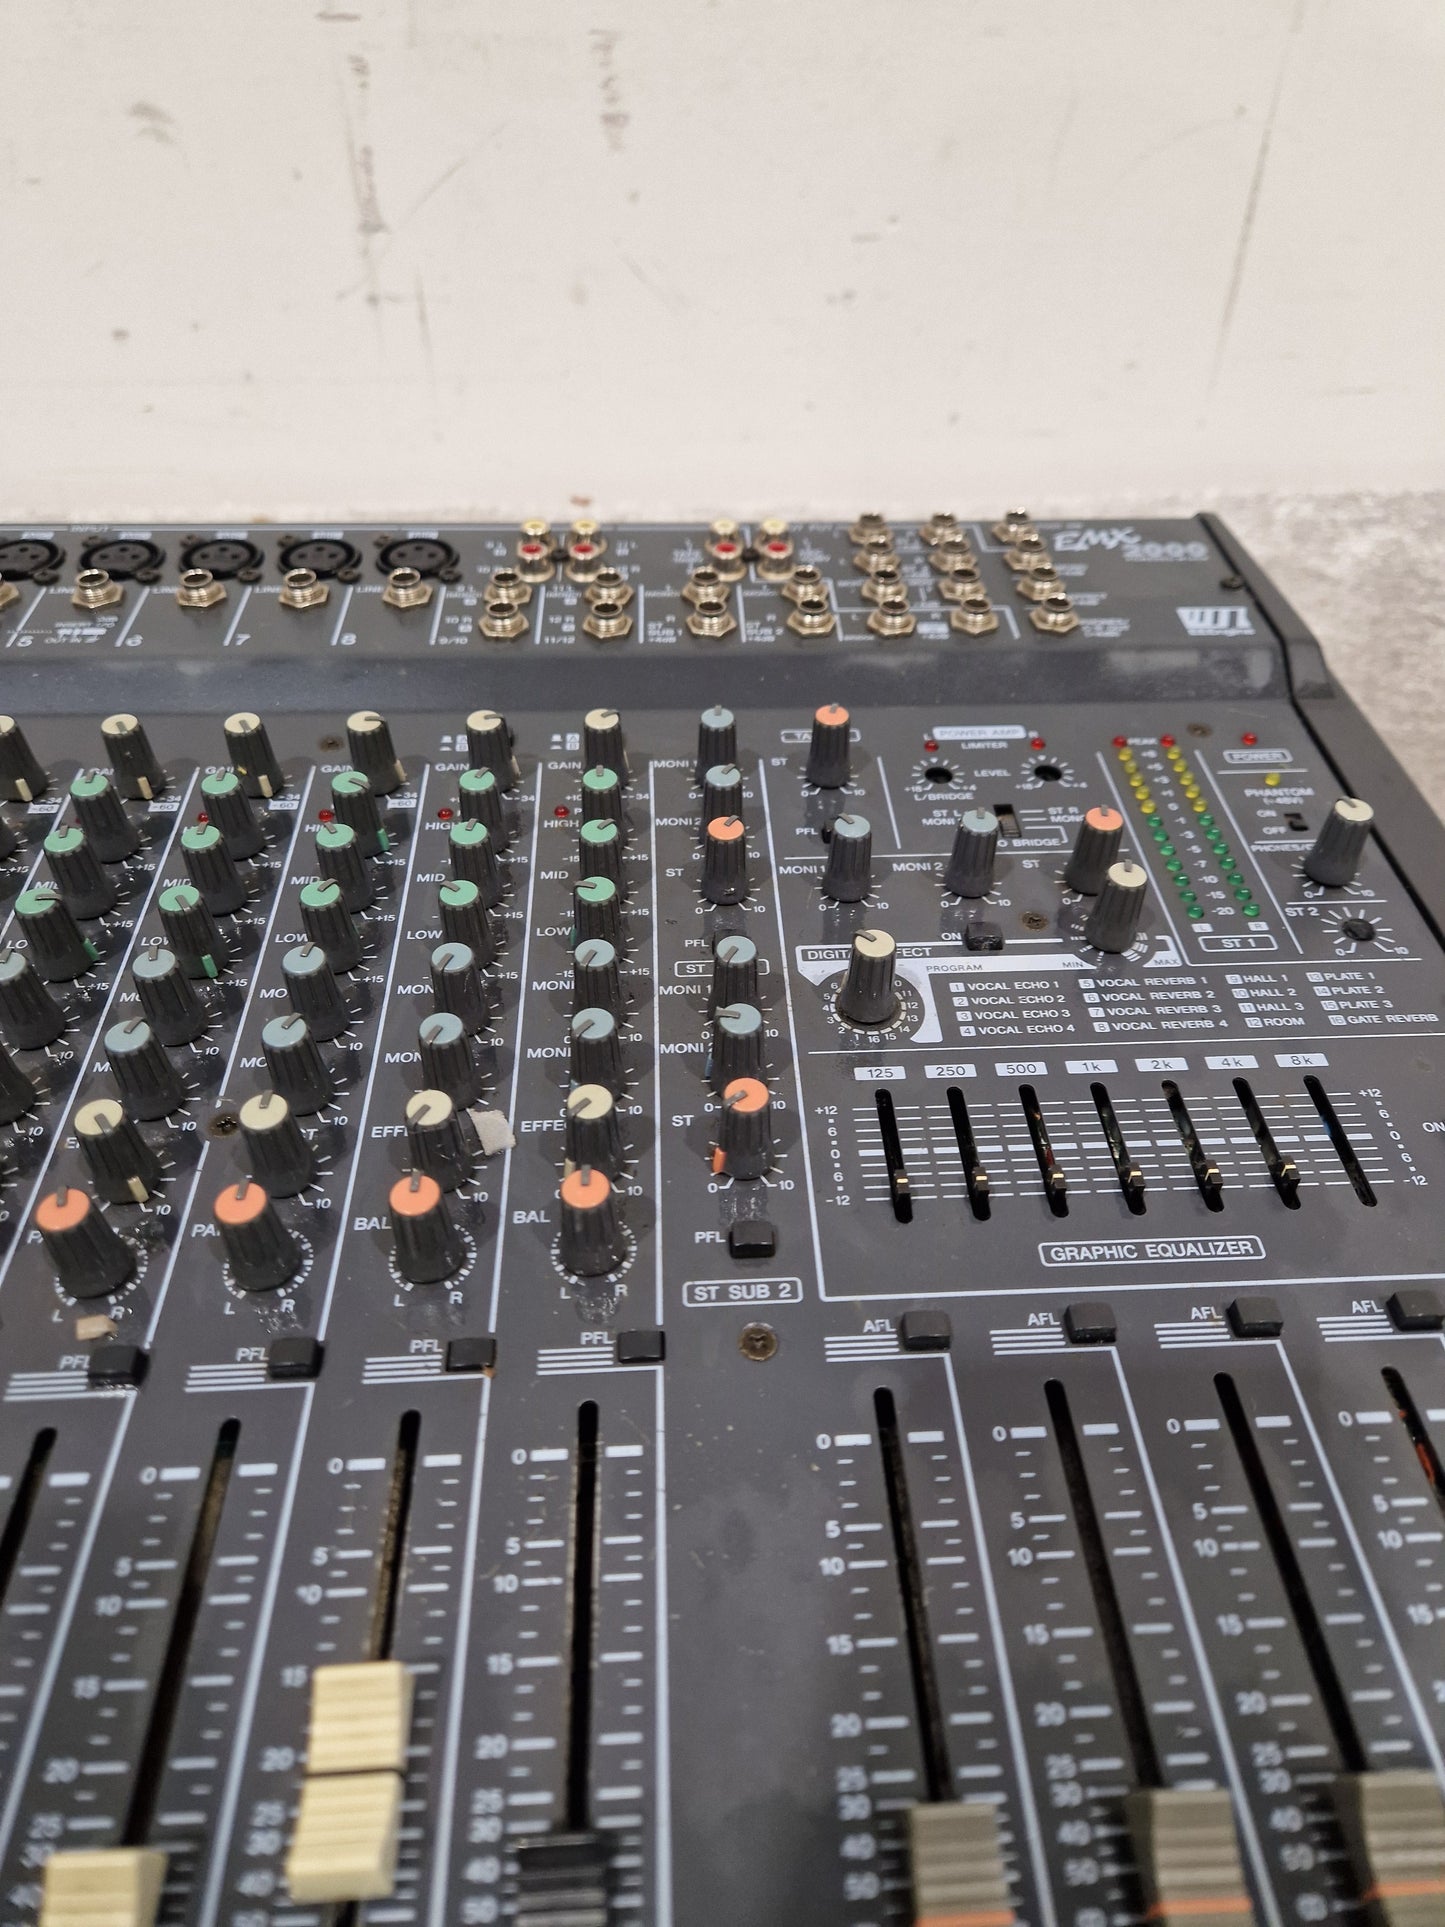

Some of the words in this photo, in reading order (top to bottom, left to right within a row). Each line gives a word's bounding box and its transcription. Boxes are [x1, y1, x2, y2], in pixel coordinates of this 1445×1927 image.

[1055, 527, 1140, 551] EMX
[127, 634, 143, 646] 6
[236, 634, 250, 645] 7
[341, 634, 356, 645] 8
[771, 758, 788, 766] ST
[974, 769, 1011, 777] LEVEL
[914, 792, 974, 801] L/BRIDGE
[544, 820, 579, 828] HIGH
[656, 818, 692, 826] MONI
[1013, 838, 1061, 847] BRIDGE
[893, 863, 931, 871] MONI
[934, 863, 943, 871] 2
[1022, 860, 1040, 868] ST
[541, 871, 569, 879] MID
[666, 869, 684, 877] ST
[779, 866, 816, 874] MONI
[417, 874, 445, 882] MID
[504, 911, 524, 919] +15
[630, 908, 649, 916] +15
[1212, 907, 1235, 915] -20
[1285, 908, 1304, 917] ST
[1309, 907, 1320, 916] 2
[407, 931, 443, 939] LOW
[537, 927, 572, 936] LOW
[685, 940, 709, 948] PFL
[1221, 939, 1243, 948] ST
[1249, 939, 1256, 947] 1
[808, 950, 852, 959] DIGIT
[896, 948, 932, 957] FECT
[686, 964, 706, 973] ST
[1097, 979, 1140, 987] VOCAL
[1145, 977, 1196, 985] REVERB
[1243, 975, 1277, 983] HALL
[1325, 973, 1364, 981] PLATE
[532, 981, 575, 990] MONI
[659, 986, 700, 994] MONI
[967, 983, 1010, 991] VOCAL
[1014, 981, 1050, 989] ECHO
[1333, 987, 1372, 995] PLATE
[1374, 986, 1385, 994] 2
[1101, 993, 1145, 1001] VOCAL
[1150, 991, 1202, 1000] REVERB
[1250, 989, 1283, 997] HALL
[1287, 988, 1297, 996] 2
[971, 997, 1014, 1005] VOCAL
[1057, 995, 1066, 1003] 2
[1339, 1001, 1380, 1009] PLATE
[975, 1011, 1018, 1019] VOCAL
[1022, 1010, 1057, 1018] ECHO
[1062, 1009, 1071, 1017] 3
[1107, 1007, 1151, 1016] VOCAL
[1157, 1006, 1208, 1014] REVERB
[1212, 1005, 1222, 1013] 3
[1264, 1018, 1306, 1026] ROOM
[1347, 1015, 1382, 1024] GATE
[1386, 1014, 1439, 1023] REVERB
[978, 1026, 1023, 1035] VOCAL
[1027, 1025, 1062, 1033] ECHO
[1066, 1024, 1075, 1032] 4
[1112, 1022, 1157, 1031] VOCAL
[1162, 1020, 1214, 1029] REVERB
[527, 1048, 571, 1058] MONI
[660, 1044, 704, 1053] MONI
[1151, 1060, 1173, 1070] 2k
[1221, 1057, 1242, 1067] 4k
[1291, 1055, 1311, 1065] 8k
[936, 1066, 966, 1076] 250
[1006, 1064, 1037, 1074] 500
[1082, 1062, 1101, 1072] 1k
[868, 1068, 894, 1078] 125
[1358, 1088, 1381, 1097] +12
[628, 1106, 643, 1114] 10
[333, 1116, 348, 1125] 10
[672, 1115, 694, 1126] ST
[779, 1181, 794, 1190] 10
[1403, 1176, 1428, 1186] -12
[627, 1187, 643, 1196] 10
[473, 1192, 488, 1202] 10
[826, 1196, 850, 1205] -12
[315, 1199, 331, 1209] 10
[156, 1205, 171, 1215] 10
[513, 1211, 551, 1223] BAL
[354, 1217, 392, 1230] BAL
[694, 1232, 726, 1244] PFL
[1050, 1244, 1138, 1261] GRAPHIC
[1146, 1242, 1254, 1259] EQUALIZER
[560, 1287, 571, 1300] L
[615, 1284, 628, 1296] R
[694, 1286, 719, 1301] ST
[728, 1284, 770, 1300] SUB
[779, 1284, 792, 1298] 2
[394, 1294, 405, 1307] L
[450, 1291, 463, 1304] R
[224, 1302, 235, 1315] L
[1352, 1301, 1384, 1314] AFL
[1191, 1307, 1222, 1320] AFL
[1028, 1313, 1060, 1326] AFL
[863, 1320, 896, 1333] AFL
[580, 1332, 616, 1345] PFL
[410, 1340, 443, 1353] PFL
[236, 1348, 269, 1361] PFL
[60, 1355, 90, 1369] PFL
[1377, 1529, 1402, 1549] 10
[1194, 1538, 1219, 1558] 10
[1008, 1547, 1034, 1566] 10
[819, 1557, 845, 1575] 10
[1407, 1604, 1434, 1625] 15
[1023, 1624, 1049, 1645] 15
[826, 1634, 854, 1655] 15
[1236, 1691, 1267, 1716] 20
[1035, 1702, 1066, 1727] 20
[830, 1712, 862, 1738] 20
